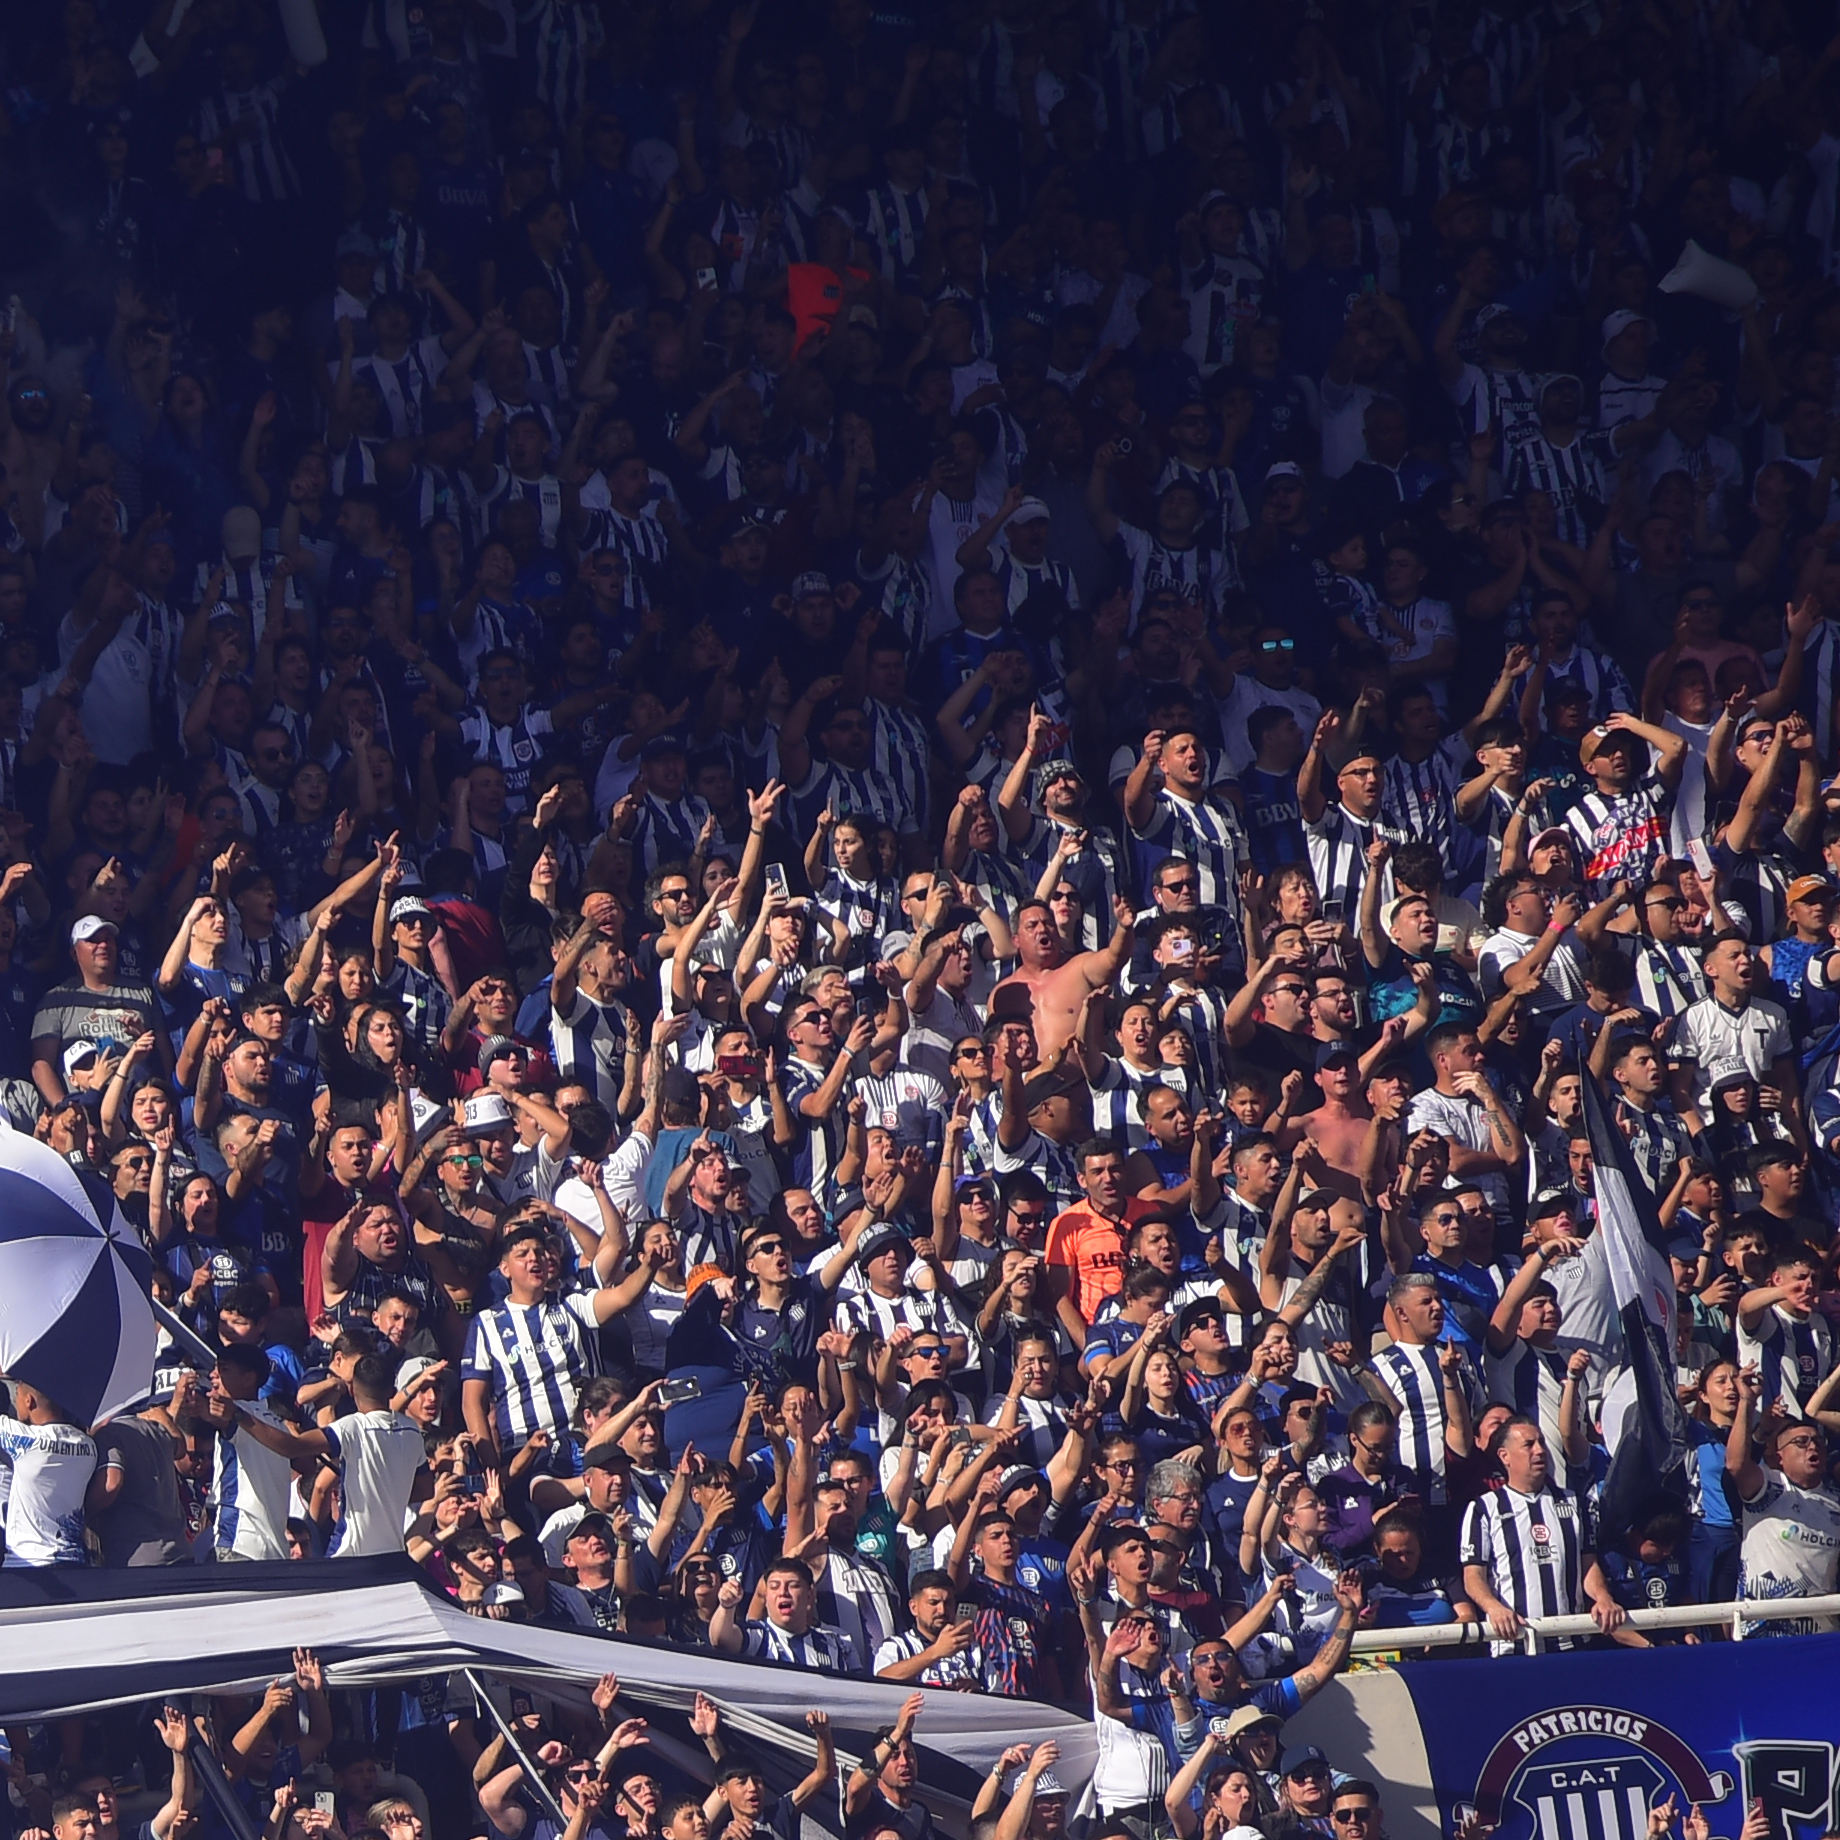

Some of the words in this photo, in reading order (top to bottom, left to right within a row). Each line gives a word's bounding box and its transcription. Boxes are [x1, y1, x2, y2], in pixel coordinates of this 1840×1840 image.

[1258, 803, 1300, 825] BBV
[119, 966, 142, 976] ICBC
[1529, 1545, 1558, 1557] ICBC
